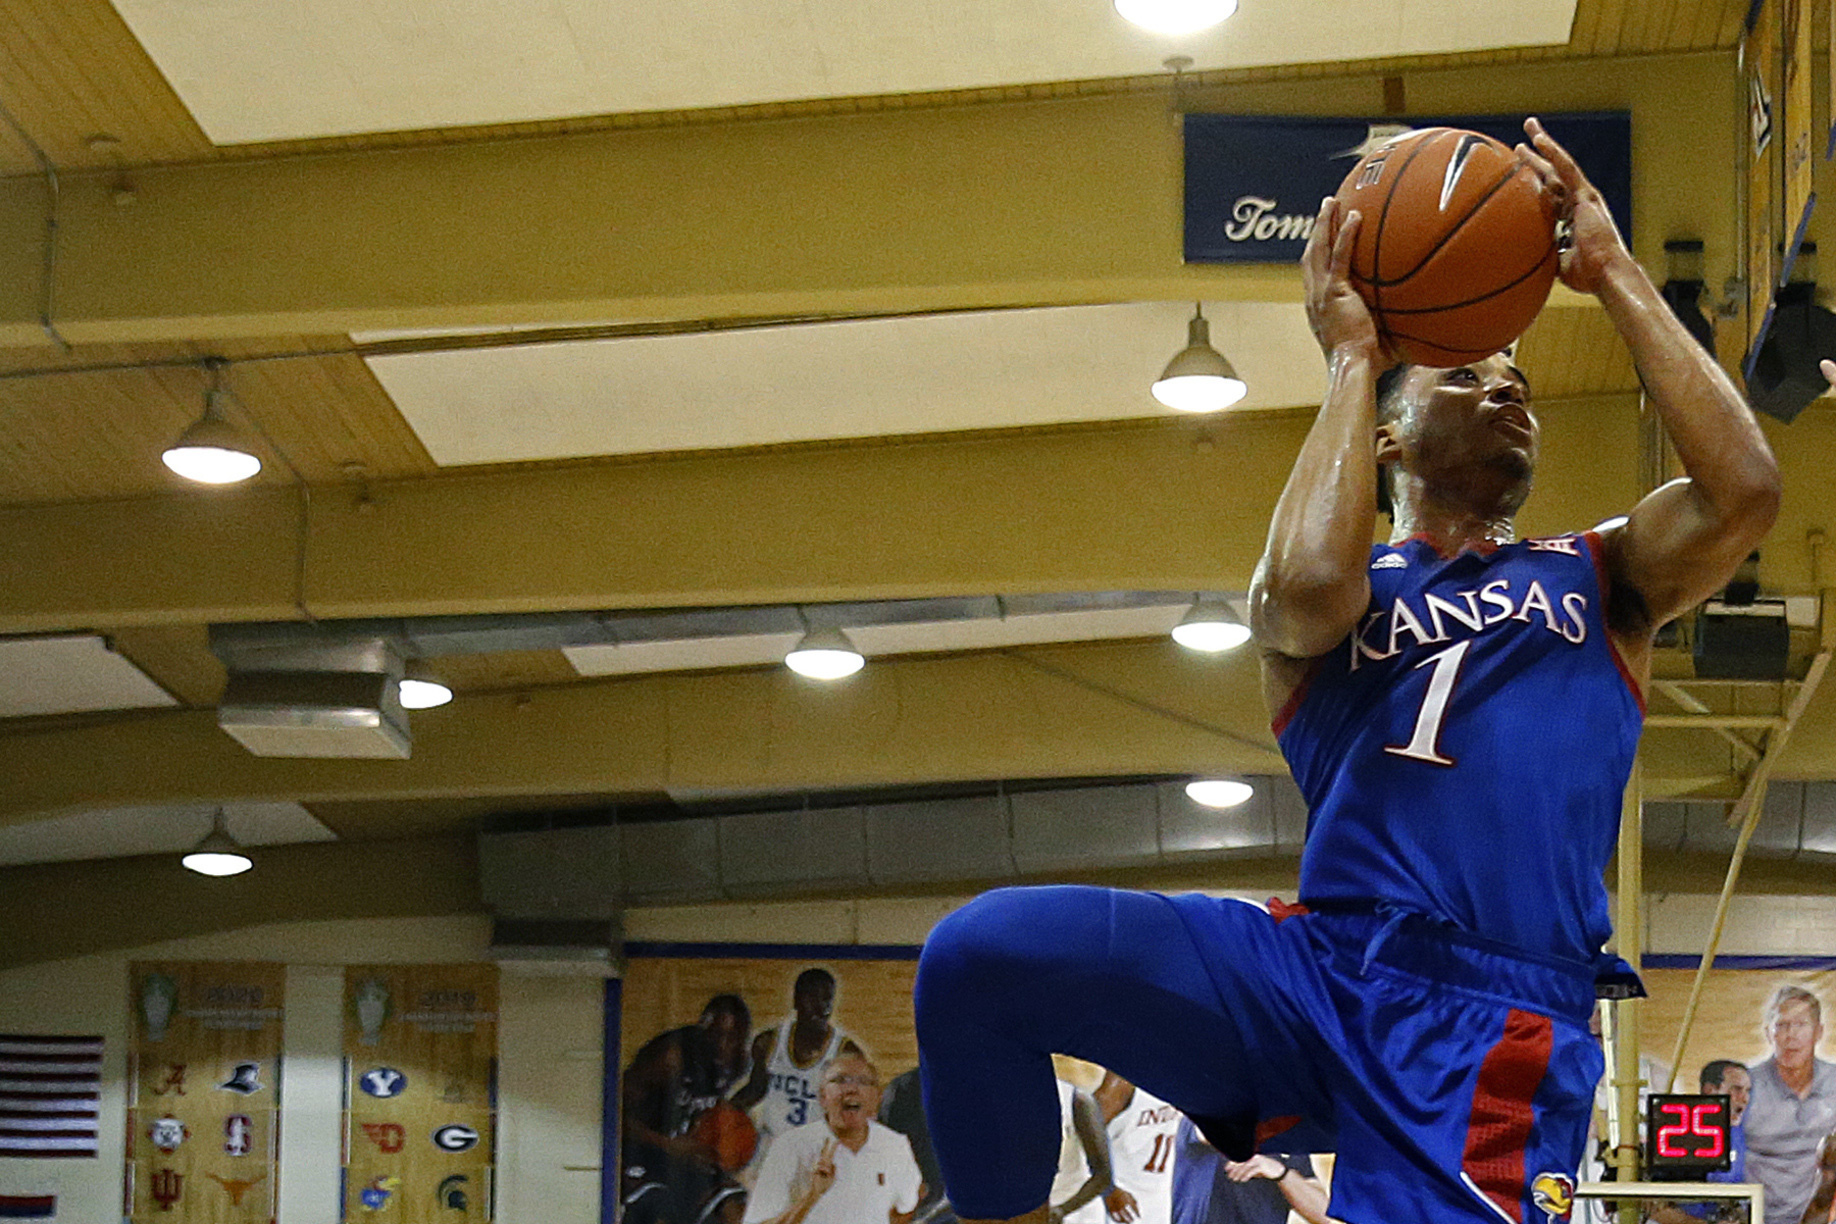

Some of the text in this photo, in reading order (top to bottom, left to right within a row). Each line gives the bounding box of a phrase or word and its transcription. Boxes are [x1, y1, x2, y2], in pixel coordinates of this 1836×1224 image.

[1349, 578, 1588, 672] KANSAS
[1384, 639, 1455, 767] 1
[1656, 1103, 1725, 1159] 25
